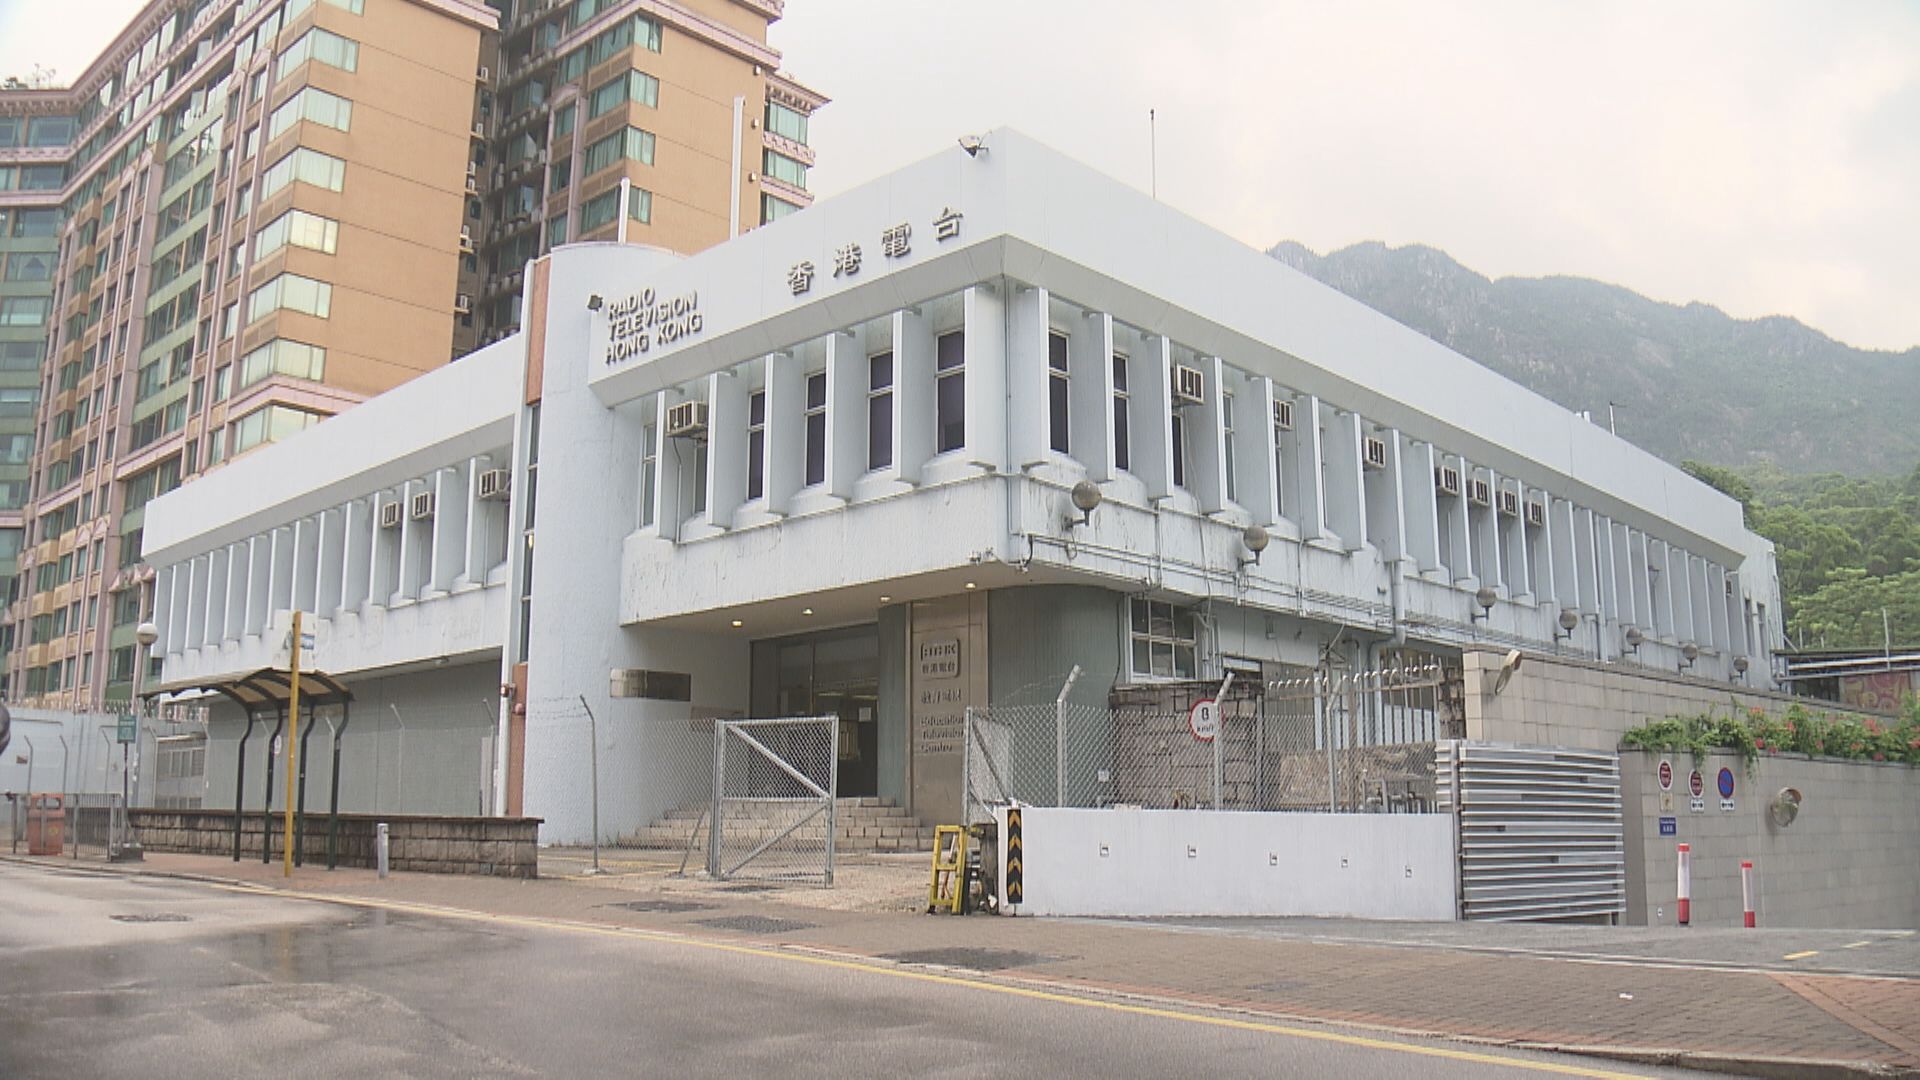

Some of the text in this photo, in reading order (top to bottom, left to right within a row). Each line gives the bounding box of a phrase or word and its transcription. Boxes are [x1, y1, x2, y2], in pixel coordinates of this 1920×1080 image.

[788, 206, 963, 296] 香港電台
[608, 287, 655, 321] RADIO
[608, 289, 698, 342] TELEVISION
[606, 313, 703, 366] HONG KONG
